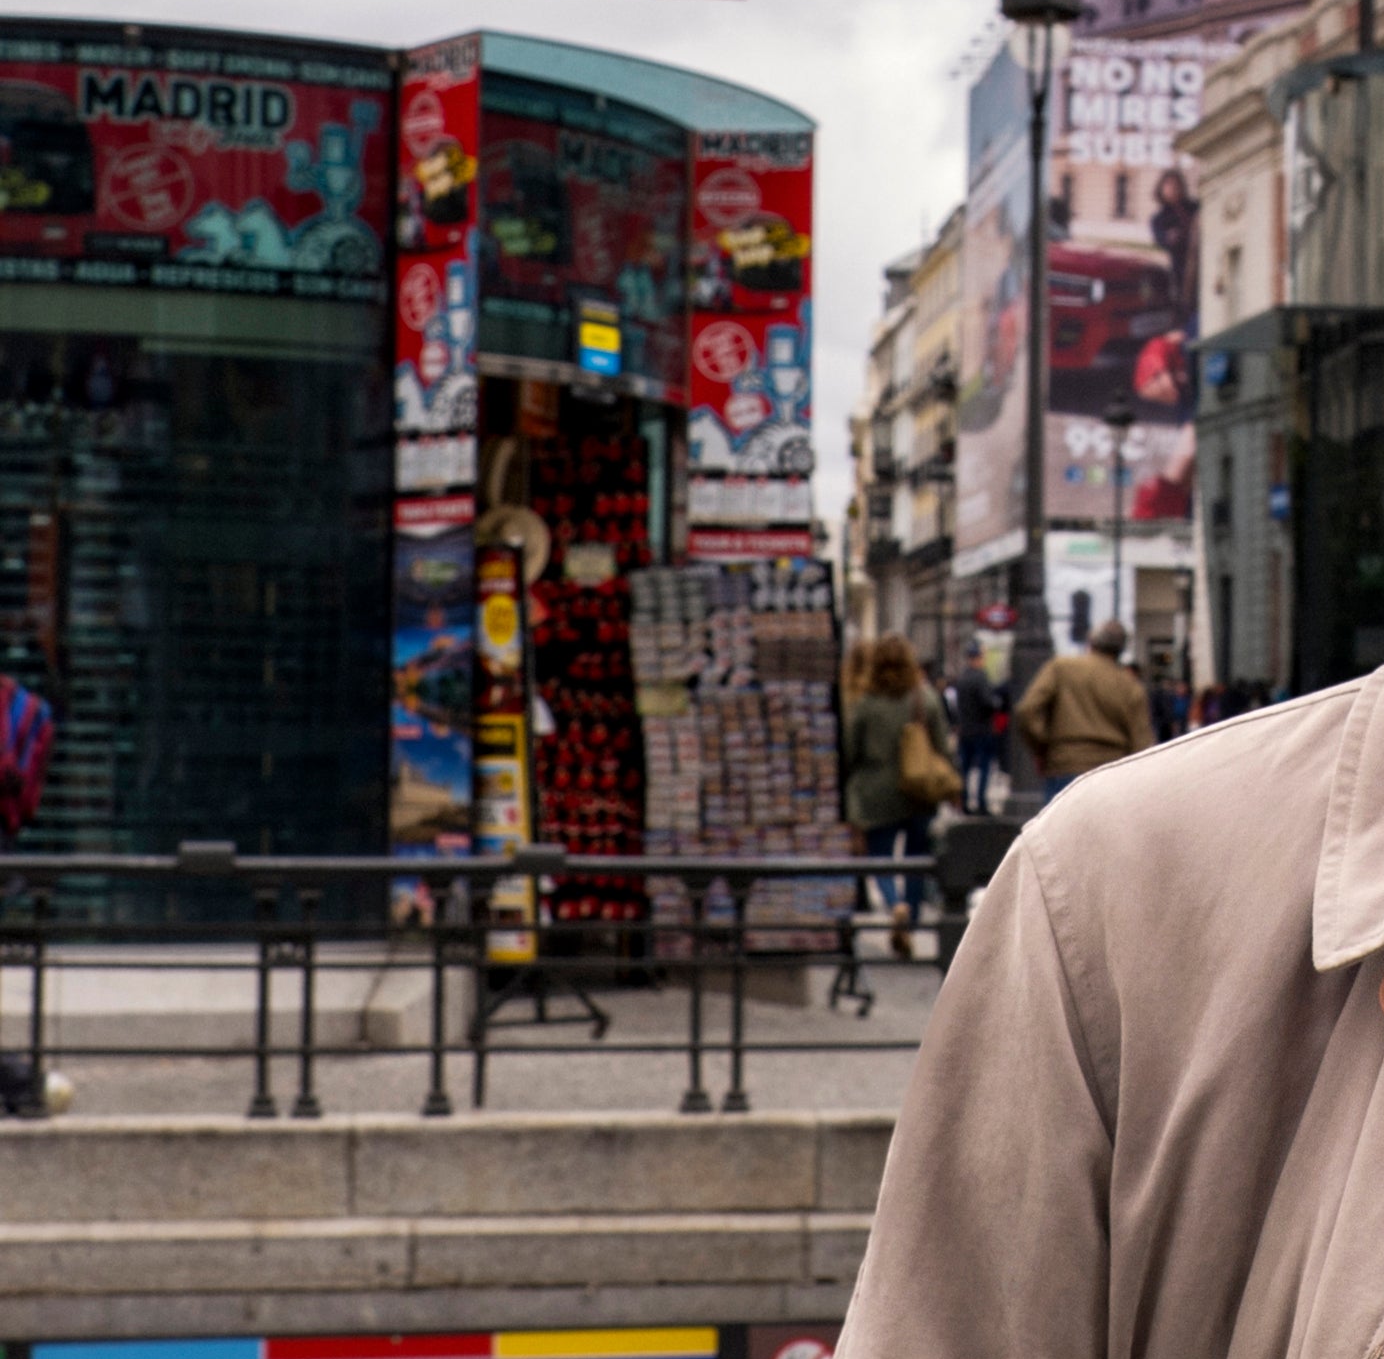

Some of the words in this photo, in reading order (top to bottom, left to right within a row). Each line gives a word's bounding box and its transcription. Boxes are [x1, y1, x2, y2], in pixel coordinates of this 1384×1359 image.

[1068, 58, 1135, 93] NO
[1140, 60, 1205, 95] NO
[80, 70, 294, 129] MADRID
[1068, 93, 1200, 131] MIRES
